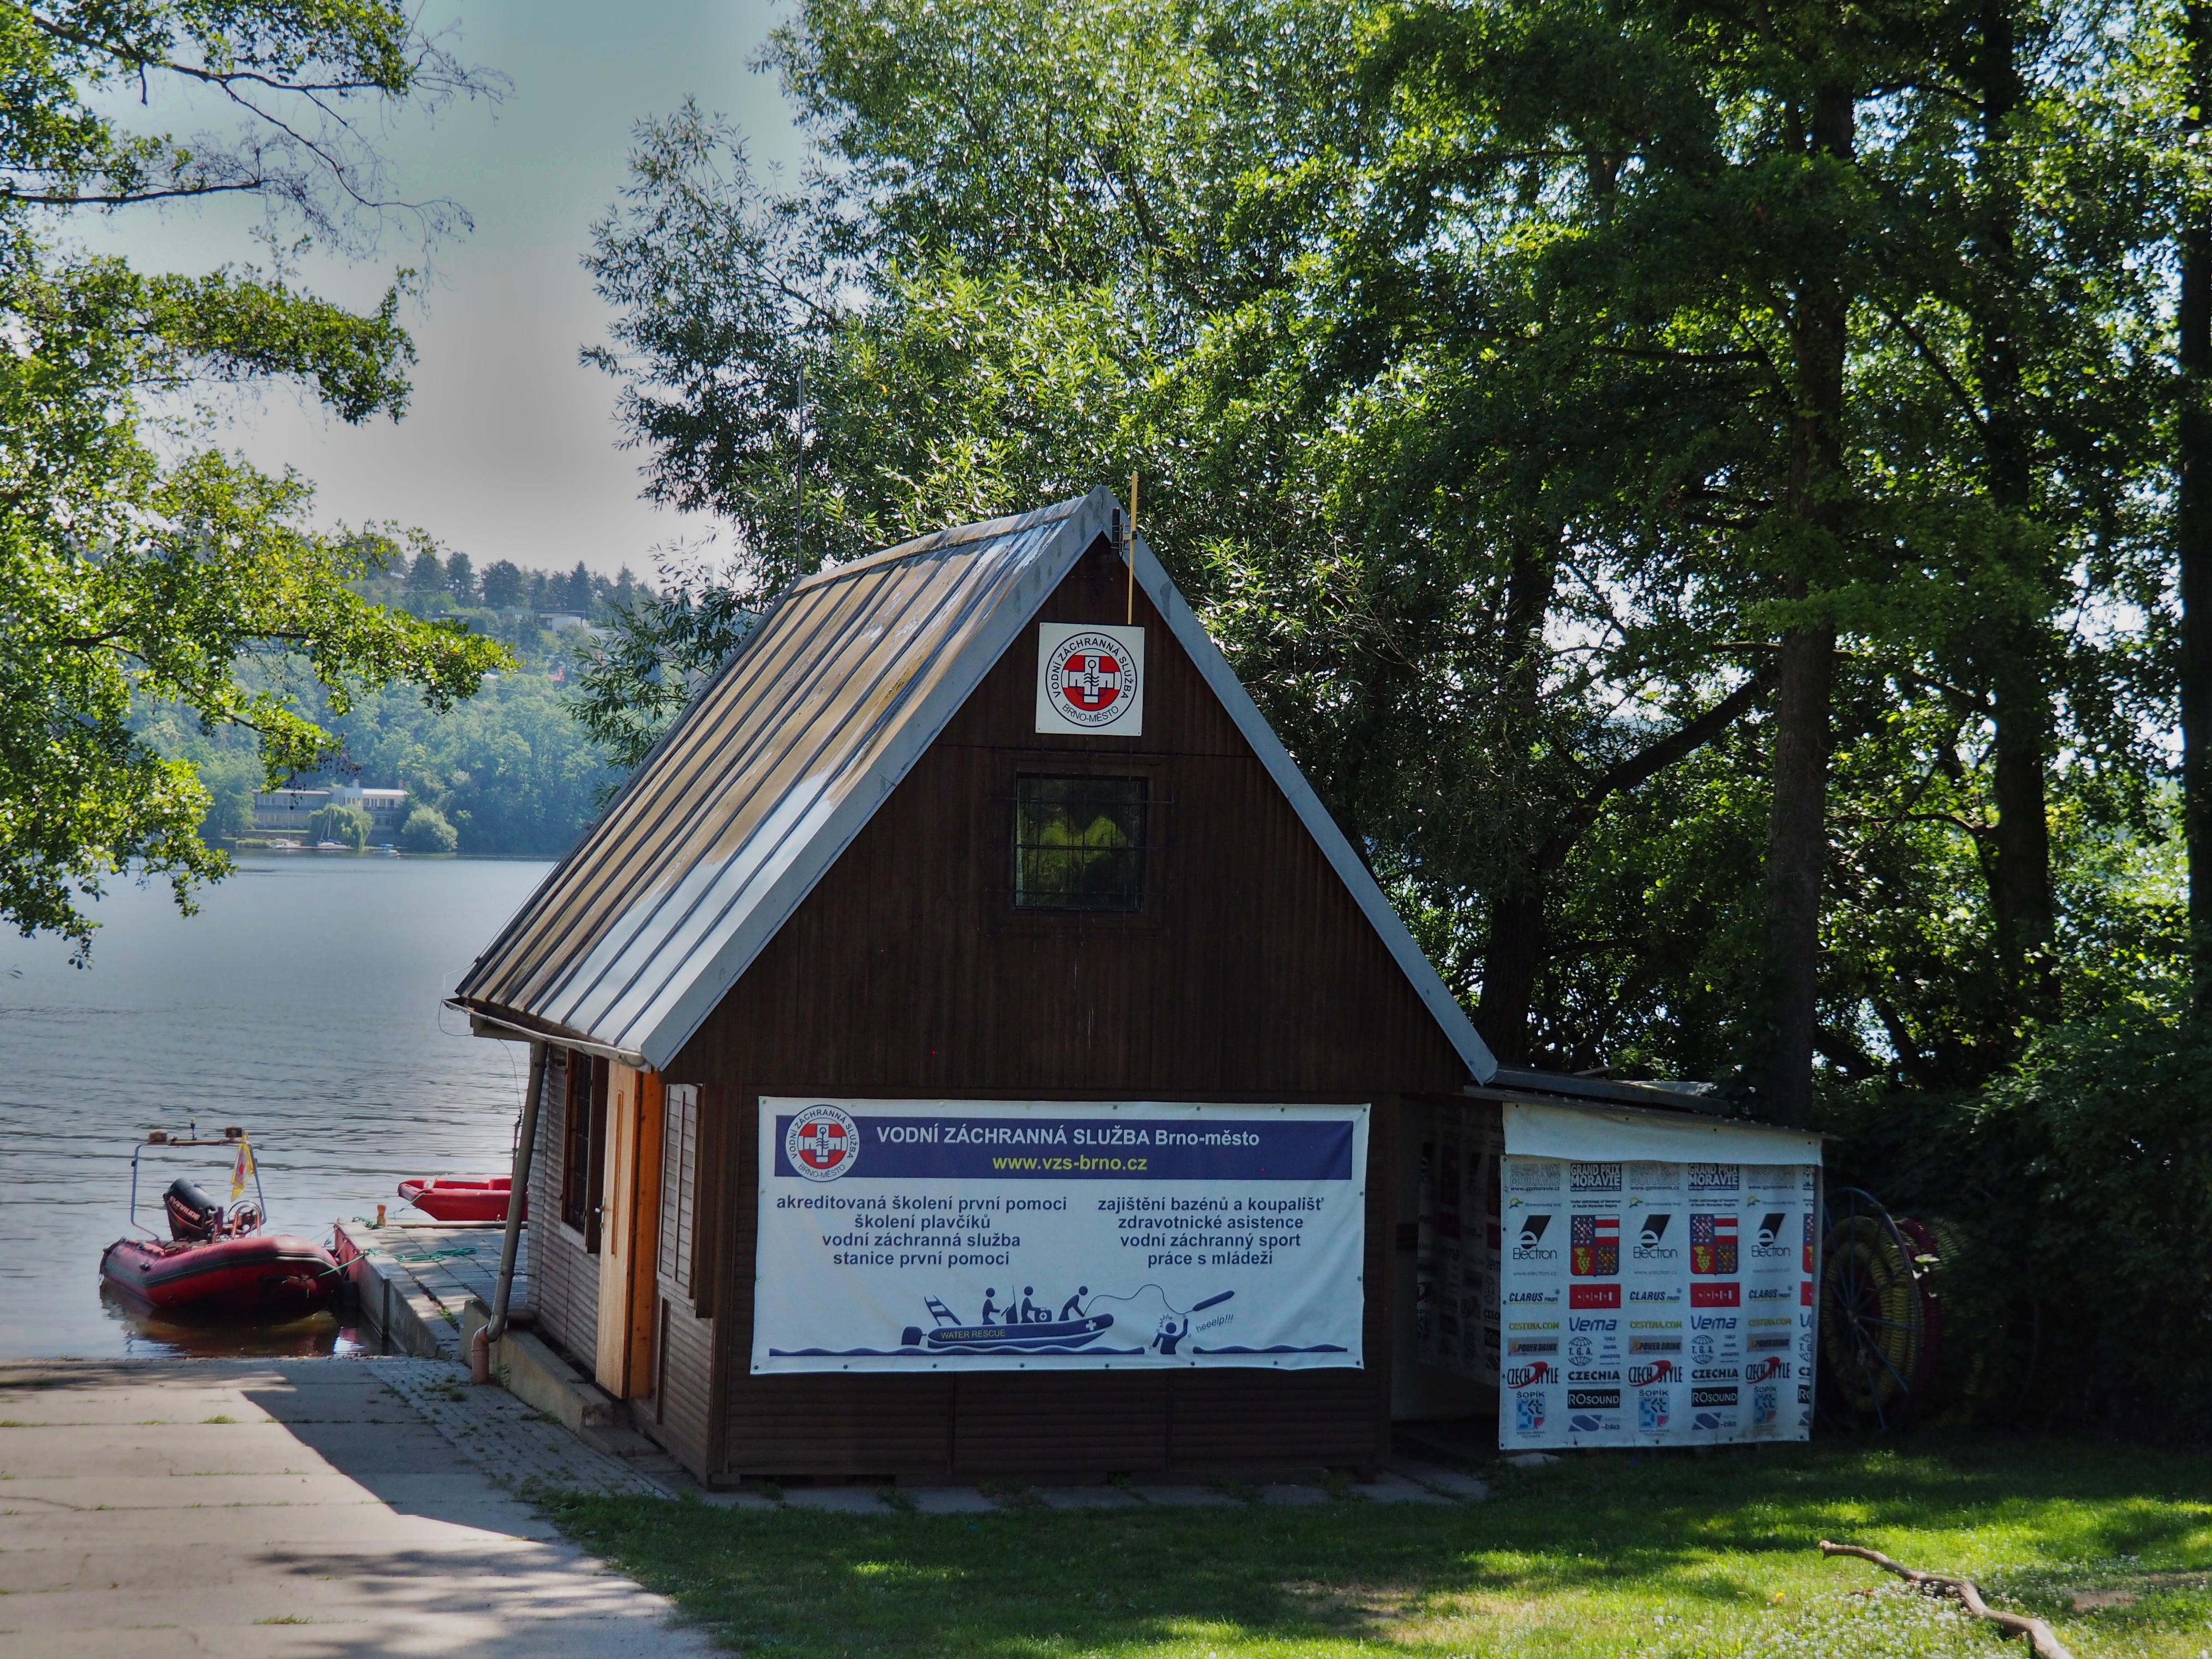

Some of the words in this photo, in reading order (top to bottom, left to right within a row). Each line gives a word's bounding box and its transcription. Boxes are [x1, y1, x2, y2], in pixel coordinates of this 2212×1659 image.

[1051, 661, 1062, 698] VODNÍ
[1058, 638, 1121, 662] ZÁCHRANNÁ
[1119, 656, 1133, 699] SLUŽBA
[1062, 703, 1119, 722] BRNO-MĚSTO
[789, 1130, 797, 1159] VODNÍ
[795, 1109, 847, 1129] ZÁCHRANNÁ
[846, 1123, 858, 1159] SLUŽBA
[877, 1124, 939, 1143] VODNÍ
[944, 1124, 1067, 1144] ZÁCHRANNÁ
[1073, 1125, 1150, 1145] SLUŽBA
[1155, 1130, 1260, 1146] Brno-město
[993, 1155, 1147, 1171] www.vzs-brno.cz
[1571, 1164, 1598, 1175] GRAND
[1600, 1164, 1620, 1175] PRIX
[1688, 1164, 1717, 1175] GRAND
[1718, 1164, 1738, 1175] PRIX
[799, 1163, 845, 1178] BRNO-MĚSTO
[1510, 1175, 1560, 1186] MORAVIE
[1571, 1175, 1620, 1186] MORAVIE
[1688, 1175, 1738, 1186] MORAVIE
[776, 1195, 886, 1209] akreditovaná
[892, 1196, 953, 1210] školení
[959, 1196, 1000, 1213] první
[1006, 1197, 1067, 1213] pomoci
[1098, 1197, 1165, 1213] zajištění
[1171, 1196, 1228, 1211] bazénů
[1234, 1200, 1243, 1211] a
[1248, 1197, 1324, 1214] koupališť
[854, 1214, 915, 1229] školení
[921, 1214, 990, 1231] plavčíků
[1118, 1215, 1222, 1229] zdravotnické
[1227, 1215, 1303, 1229] asistence
[823, 1232, 869, 1246] vodní
[874, 1233, 961, 1247] záchranná
[967, 1233, 1021, 1248] služba
[1120, 1233, 1165, 1247] vodní
[1170, 1233, 1253, 1250] záchranný
[1259, 1234, 1301, 1250] sport
[1513, 1248, 1557, 1260] Electron
[1633, 1246, 1678, 1259] Electron
[1751, 1245, 1791, 1257] Electron
[833, 1251, 894, 1265] stanice
[900, 1251, 942, 1268] první
[948, 1251, 1010, 1268] pomoci
[1148, 1251, 1192, 1268] práce
[1198, 1254, 1206, 1265] s
[1212, 1251, 1273, 1265] mládeží
[1509, 1292, 1543, 1302] CLARUS
[1630, 1291, 1665, 1301] CLARUS
[1749, 1289, 1777, 1298] CLARUS
[1569, 1317, 1616, 1331] Vema
[1691, 1315, 1737, 1329] Vema
[941, 1331, 969, 1339] WATER
[972, 1329, 1005, 1337] RESCUE
[1507, 1368, 1530, 1385] CZECH
[1536, 1368, 1558, 1384] STYLE
[1568, 1371, 1620, 1380] CZECHIA
[1629, 1366, 1652, 1384] CZECH
[1658, 1366, 1682, 1383] STYLE
[1692, 1369, 1739, 1379] CZECHIA
